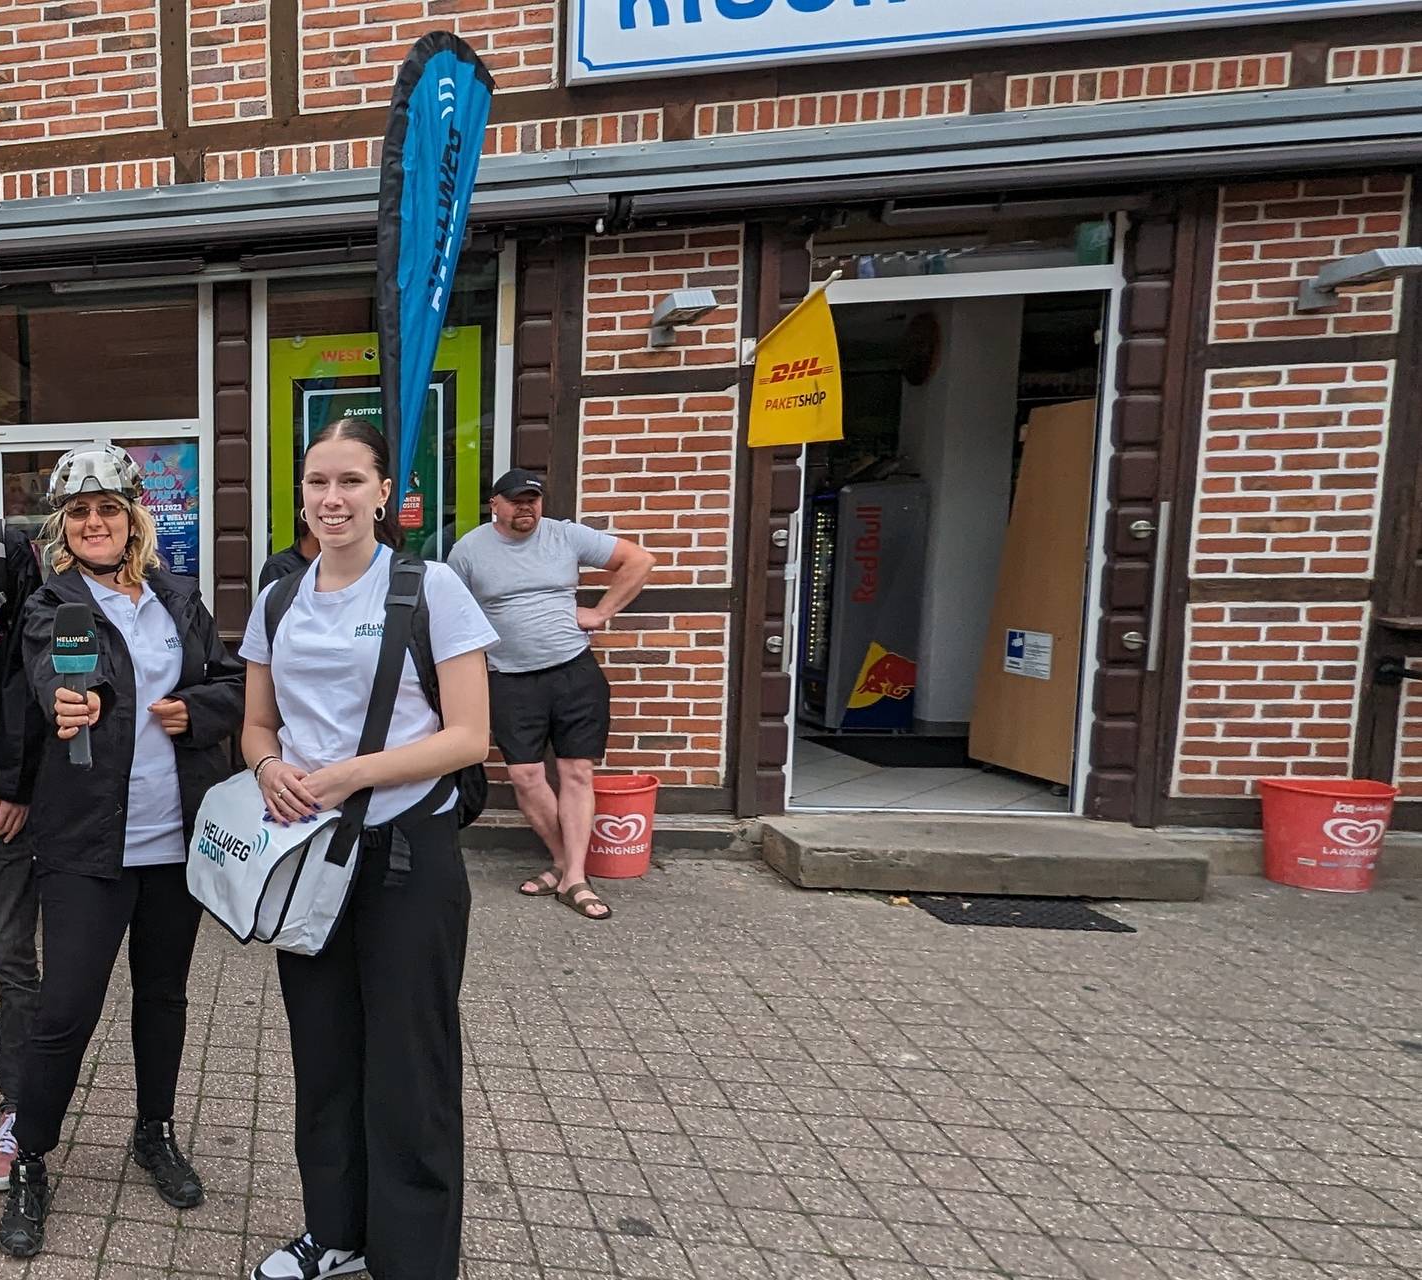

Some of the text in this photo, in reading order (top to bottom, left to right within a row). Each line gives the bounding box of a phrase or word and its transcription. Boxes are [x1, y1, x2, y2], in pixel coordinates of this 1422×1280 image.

[428, 119, 461, 304] LLWEG
[321, 349, 362, 361] WEST
[770, 357, 824, 384] DHL
[353, 407, 377, 416] LOTTO
[764, 391, 827, 411] PAKETSHOP
[852, 506, 882, 604] Red Bull
[355, 623, 384, 632] HELLW
[203, 819, 251, 862] HELLWEG
[591, 842, 645, 856] LANGNESE
[198, 837, 225, 868] RADIO
